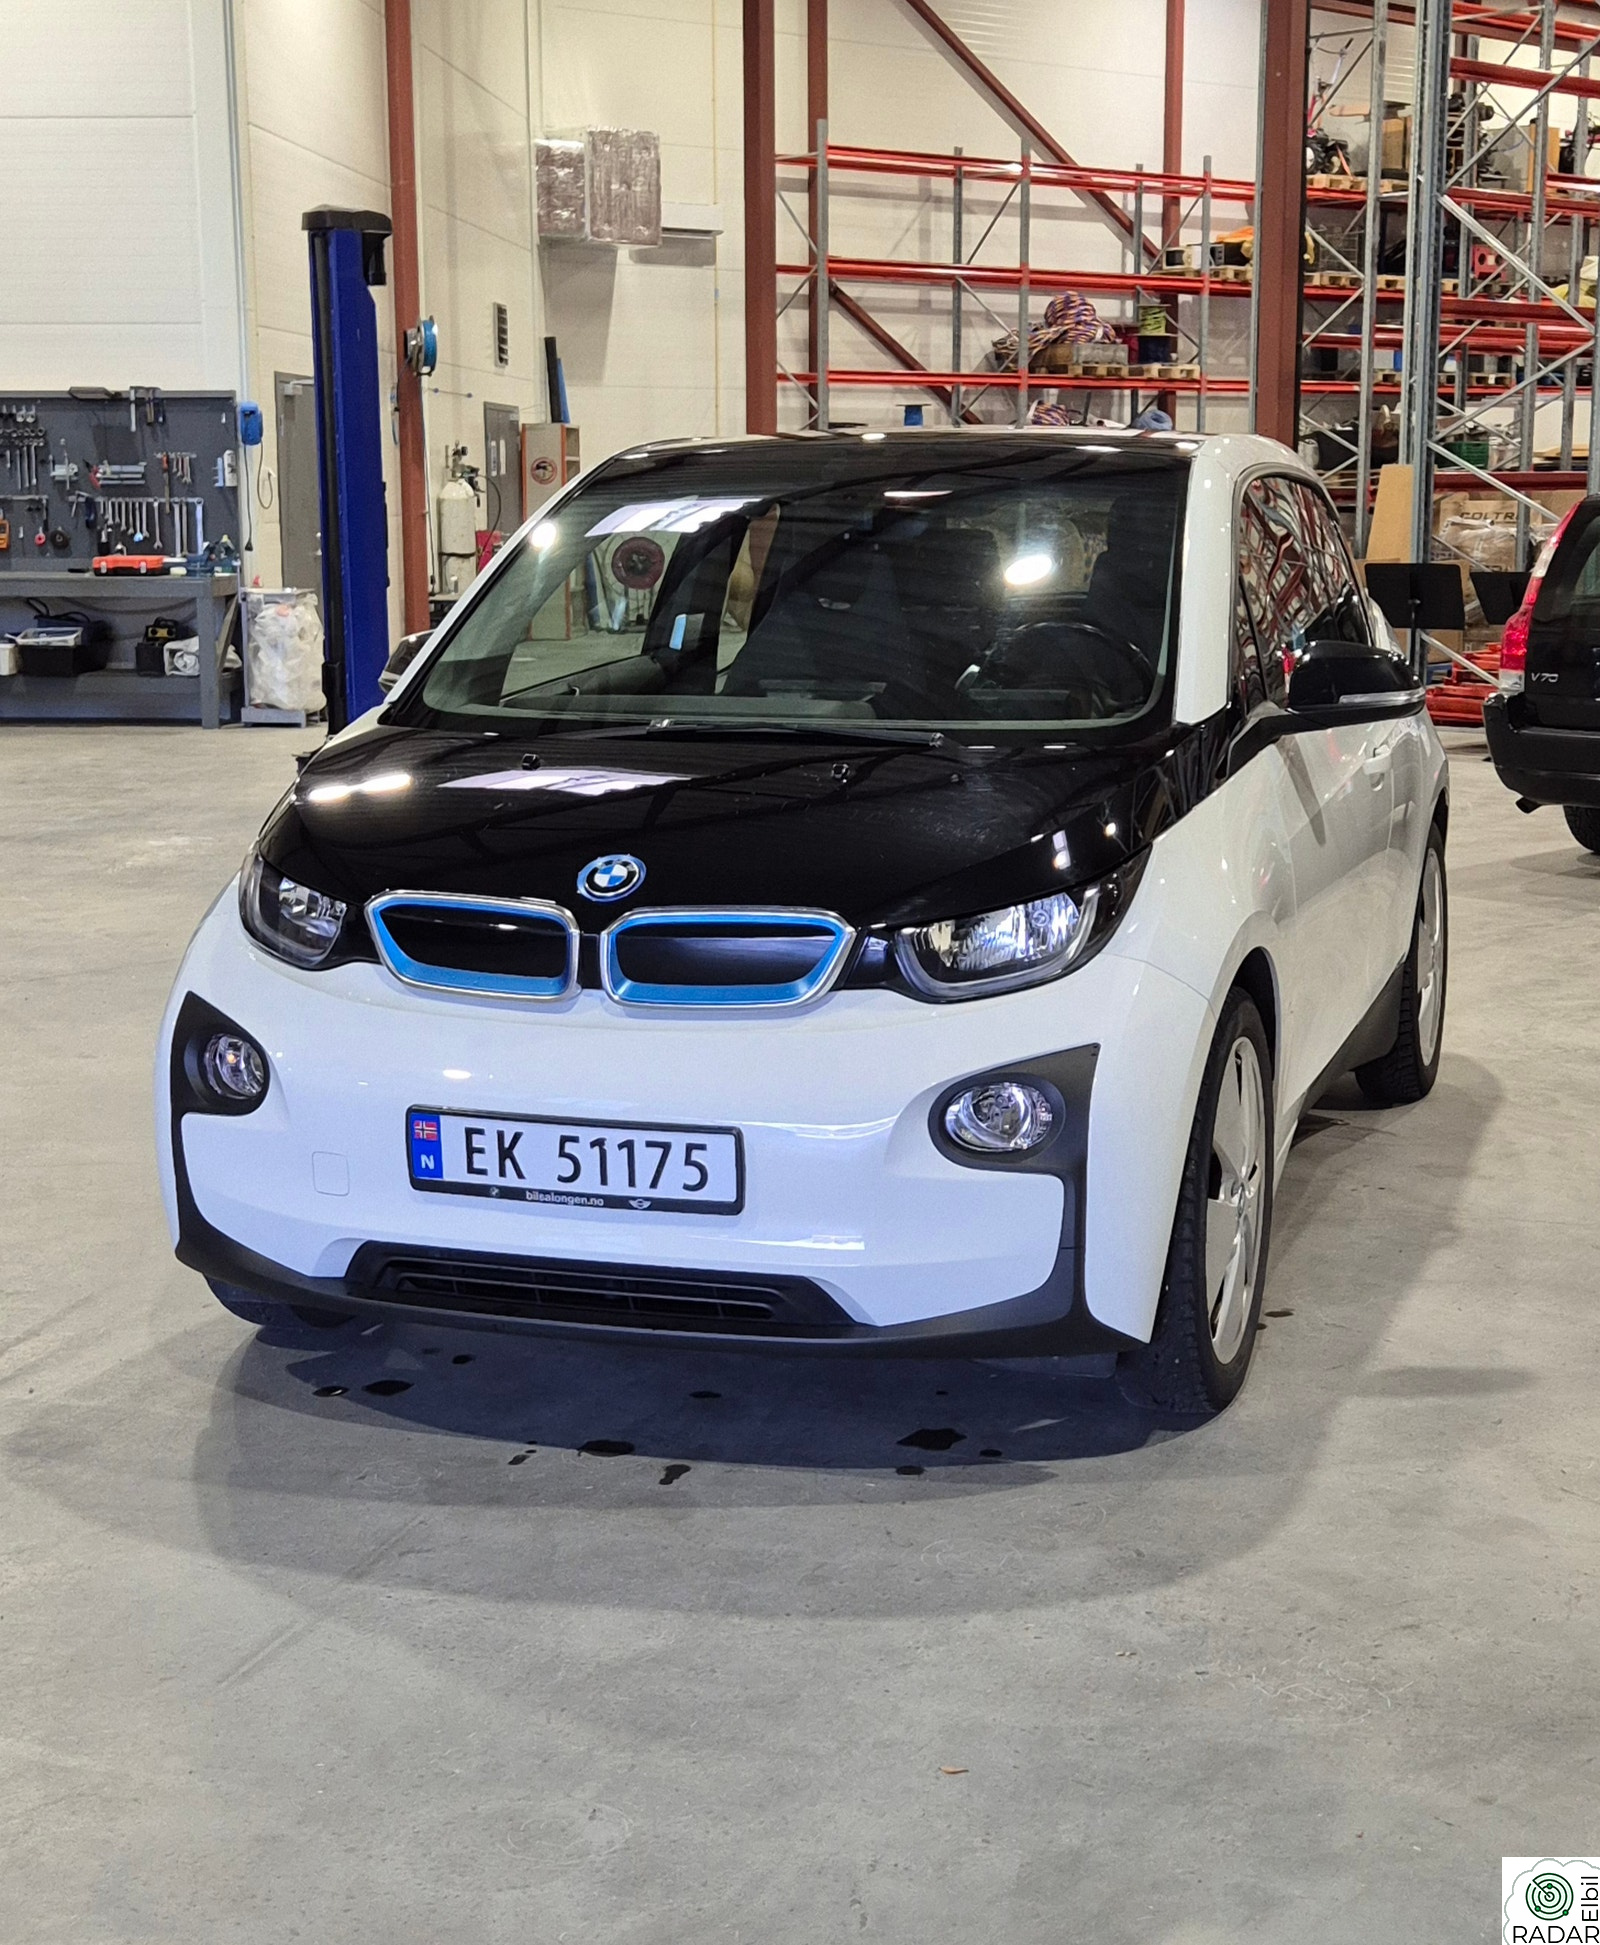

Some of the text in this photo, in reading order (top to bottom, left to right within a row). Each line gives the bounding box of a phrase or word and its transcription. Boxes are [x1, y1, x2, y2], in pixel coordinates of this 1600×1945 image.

[1460, 511, 1519, 521] COLTR
[1531, 672, 1559, 682] V70
[420, 1154, 435, 1170] N
[464, 1126, 708, 1192] EK 51175
[526, 1190, 604, 1206] bilsalongen.no
